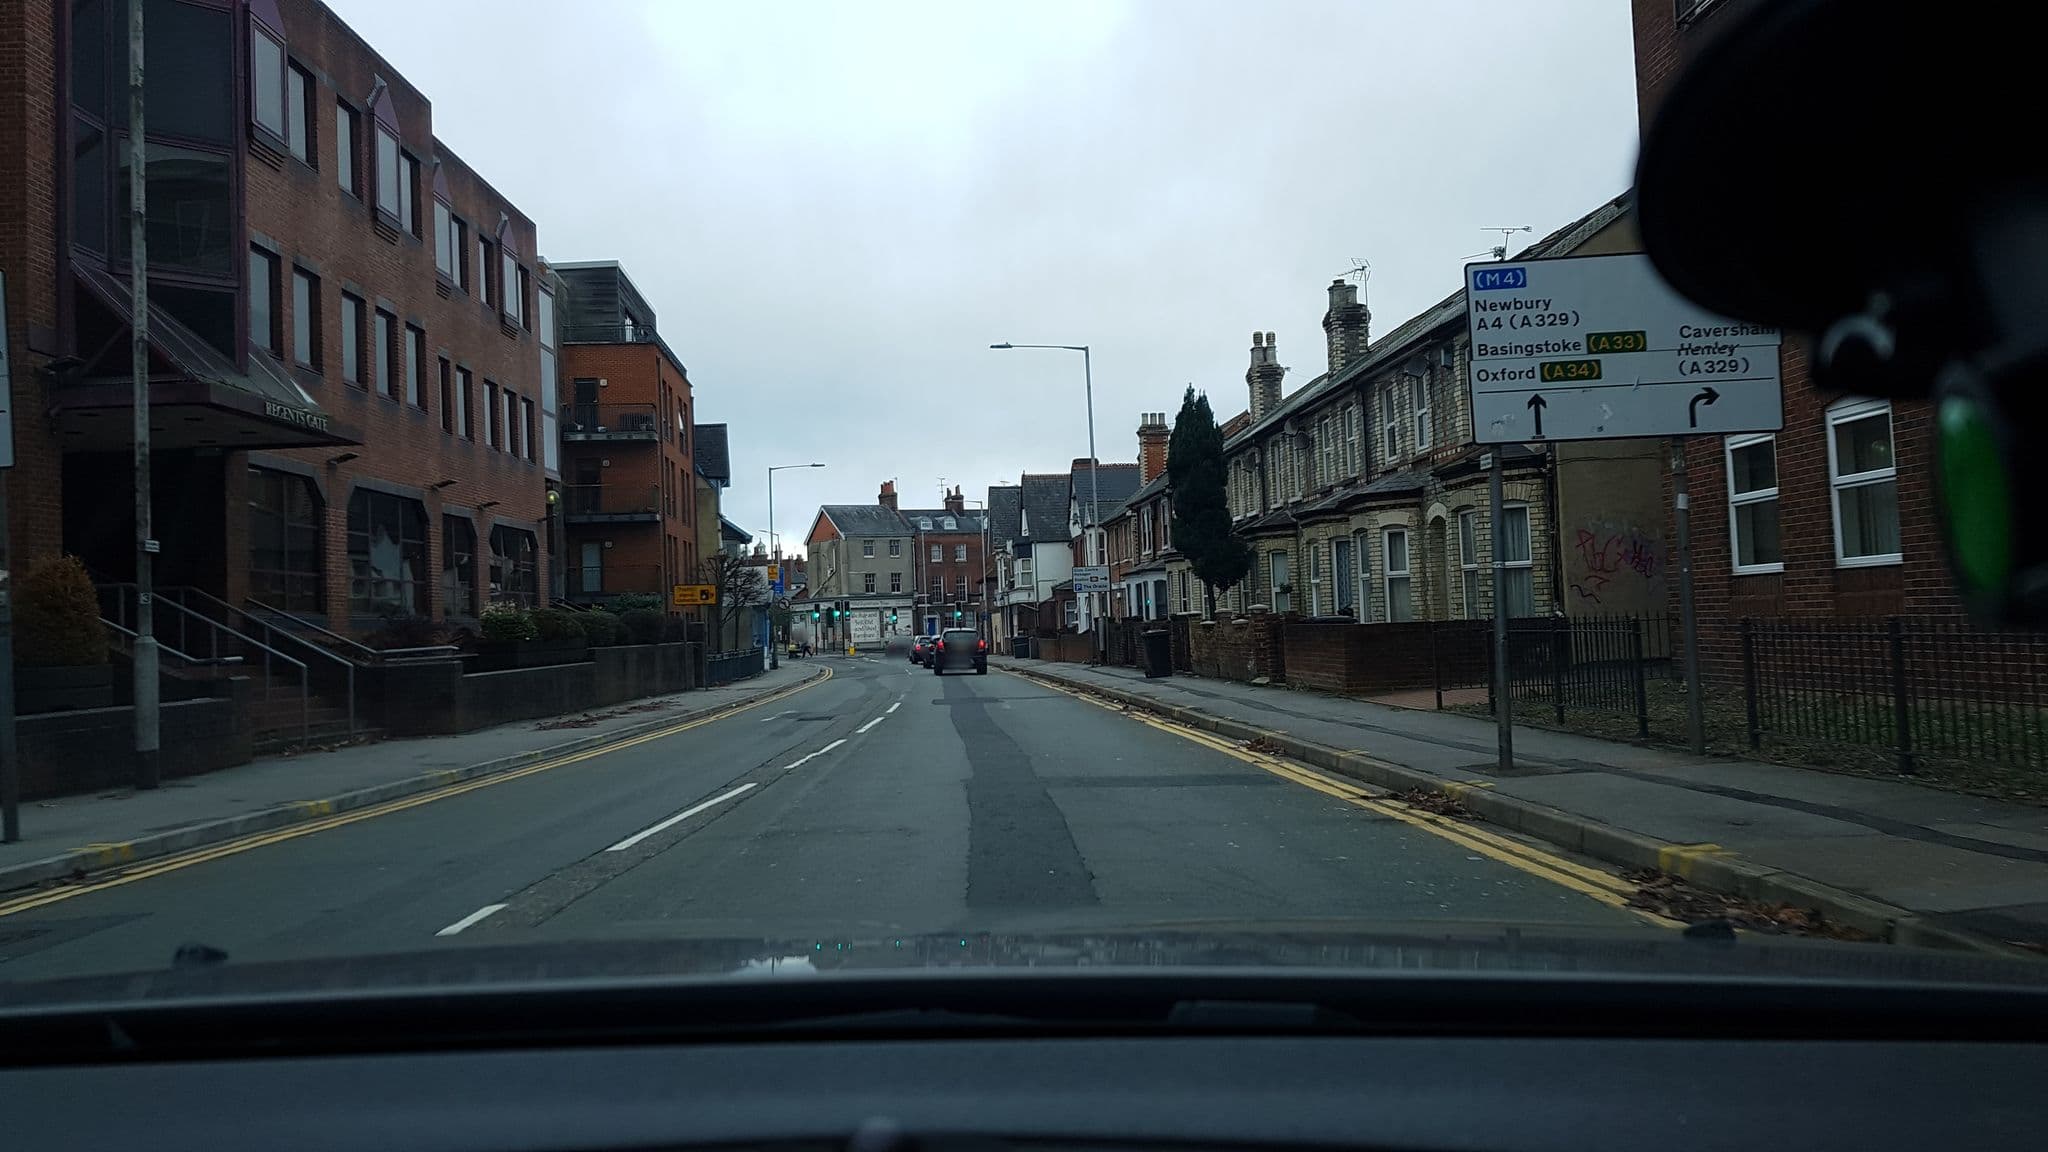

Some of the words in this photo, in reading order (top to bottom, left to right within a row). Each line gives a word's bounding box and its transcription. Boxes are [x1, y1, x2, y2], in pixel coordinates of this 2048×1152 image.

[1475, 269, 1524, 288] (M4)
[1475, 298, 1552, 313] Newbury
[1477, 316, 1503, 331] A4
[1510, 311, 1580, 330] (A329)
[1478, 339, 1582, 357] Basingstoke
[1589, 333, 1645, 352] (A33)
[1476, 366, 1536, 383] Oxford
[1543, 361, 1599, 379] (A34)
[1679, 357, 1749, 376] (A329)
[265, 401, 305, 424] REGENTS
[306, 414, 329, 432] GATE
